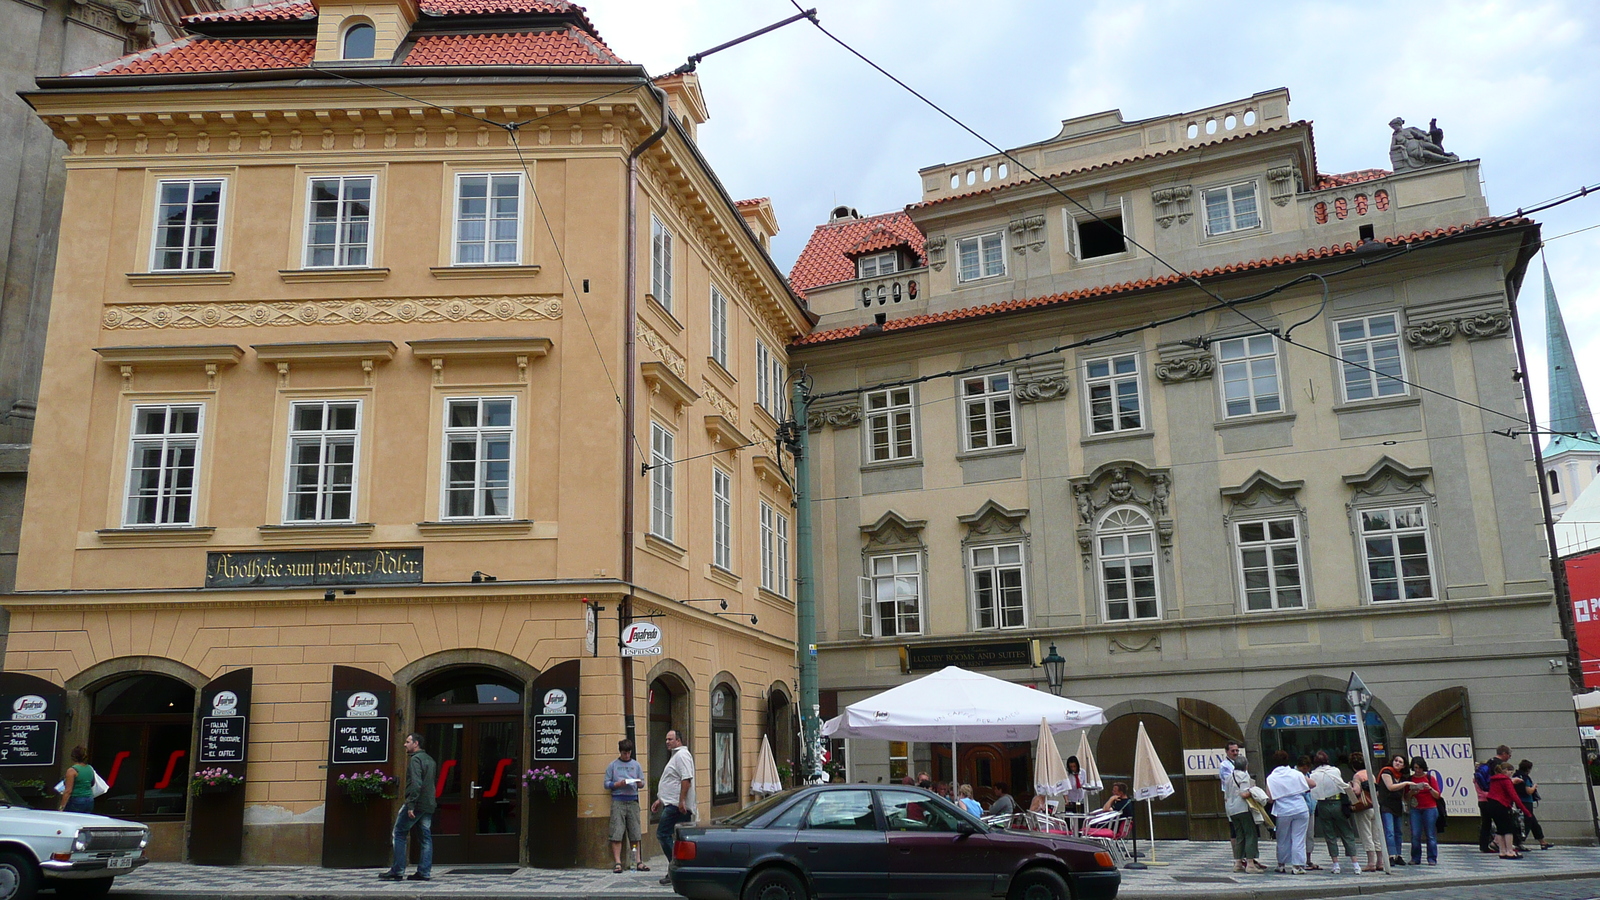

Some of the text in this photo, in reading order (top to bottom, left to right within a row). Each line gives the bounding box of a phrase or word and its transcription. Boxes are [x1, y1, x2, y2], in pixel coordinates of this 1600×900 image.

[209, 554, 283, 581] Apotheke
[284, 562, 314, 576] zum
[318, 555, 366, 579] weißen
[626, 627, 658, 643] Segafredo
[946, 653, 975, 661] ROOMS
[978, 652, 996, 660] AND
[998, 651, 1025, 659] SUITES
[1283, 714, 1358, 726] CHANGE
[1409, 743, 1472, 759] CHANGE
